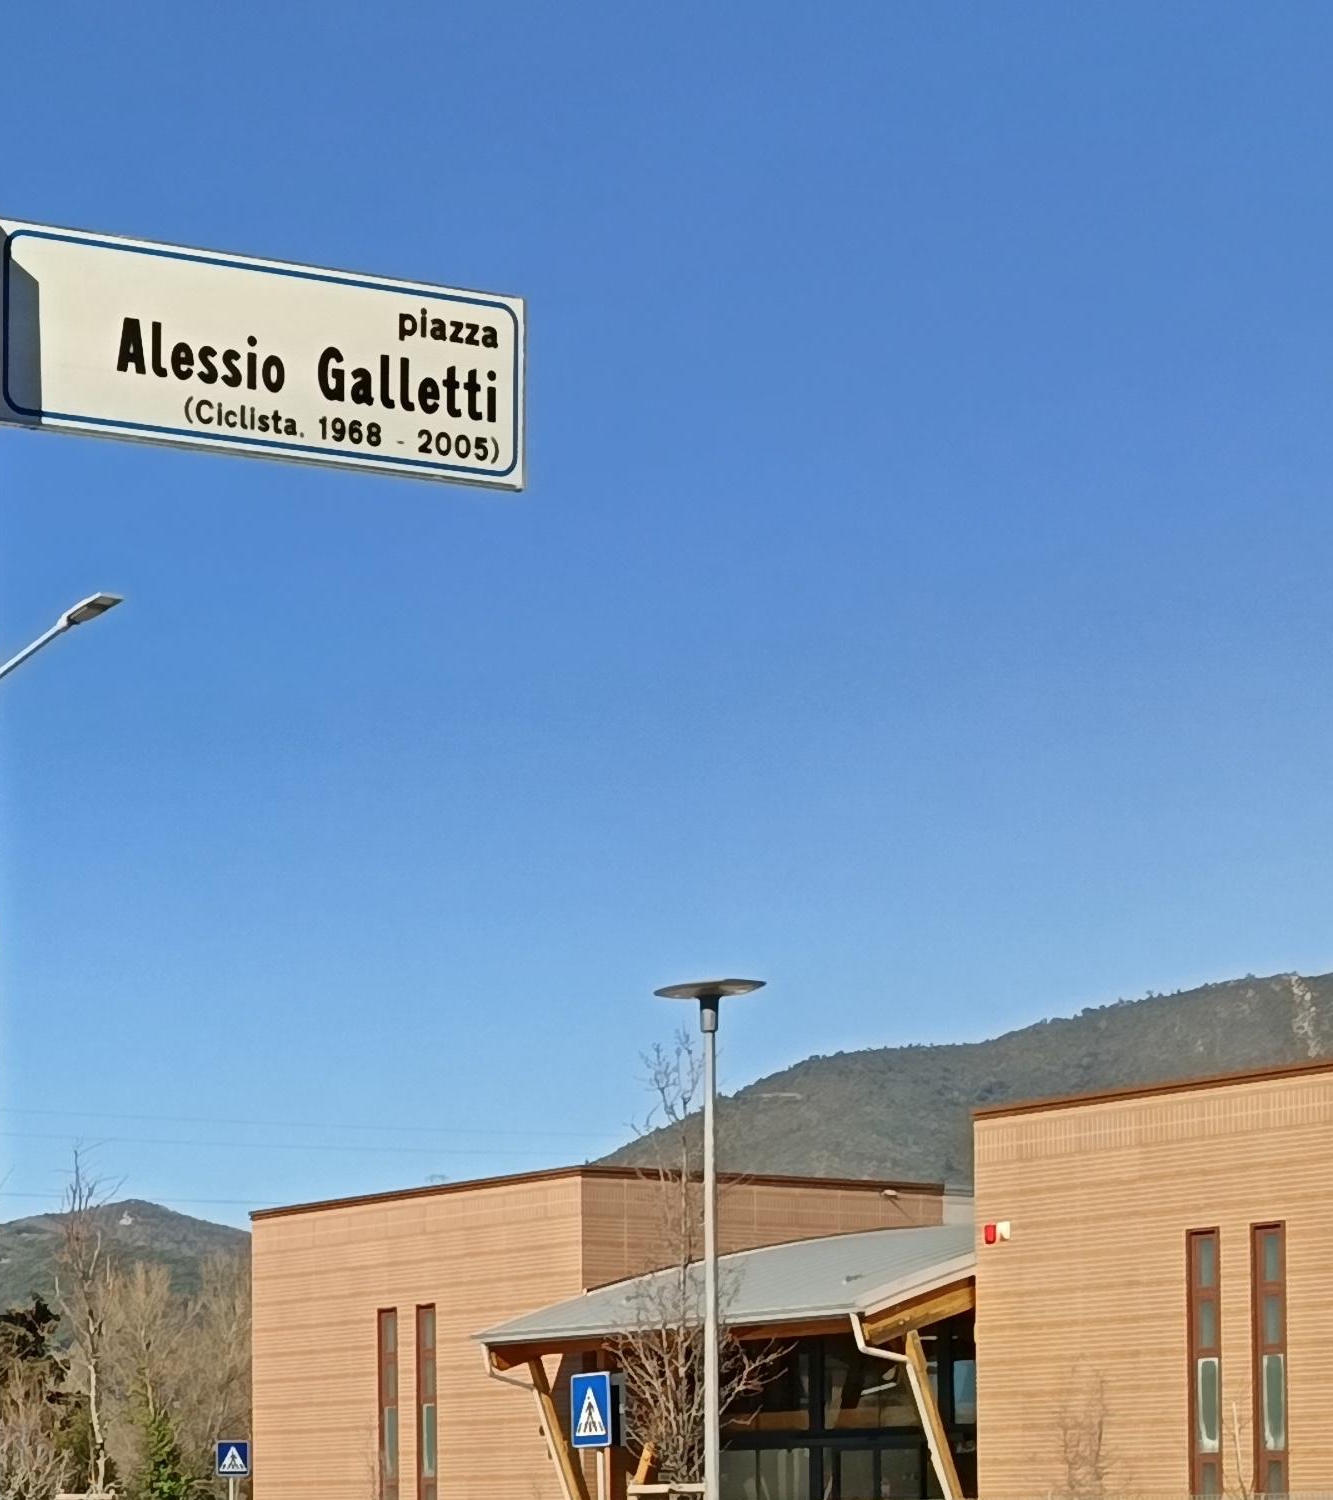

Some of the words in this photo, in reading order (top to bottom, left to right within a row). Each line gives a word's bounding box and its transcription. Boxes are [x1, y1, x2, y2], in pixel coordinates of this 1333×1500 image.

[399, 308, 499, 349] piazza
[116, 317, 286, 393] Alessio
[317, 346, 498, 423] Galletti
[318, 415, 382, 447] 1968
[417, 429, 500, 464] 2005)
